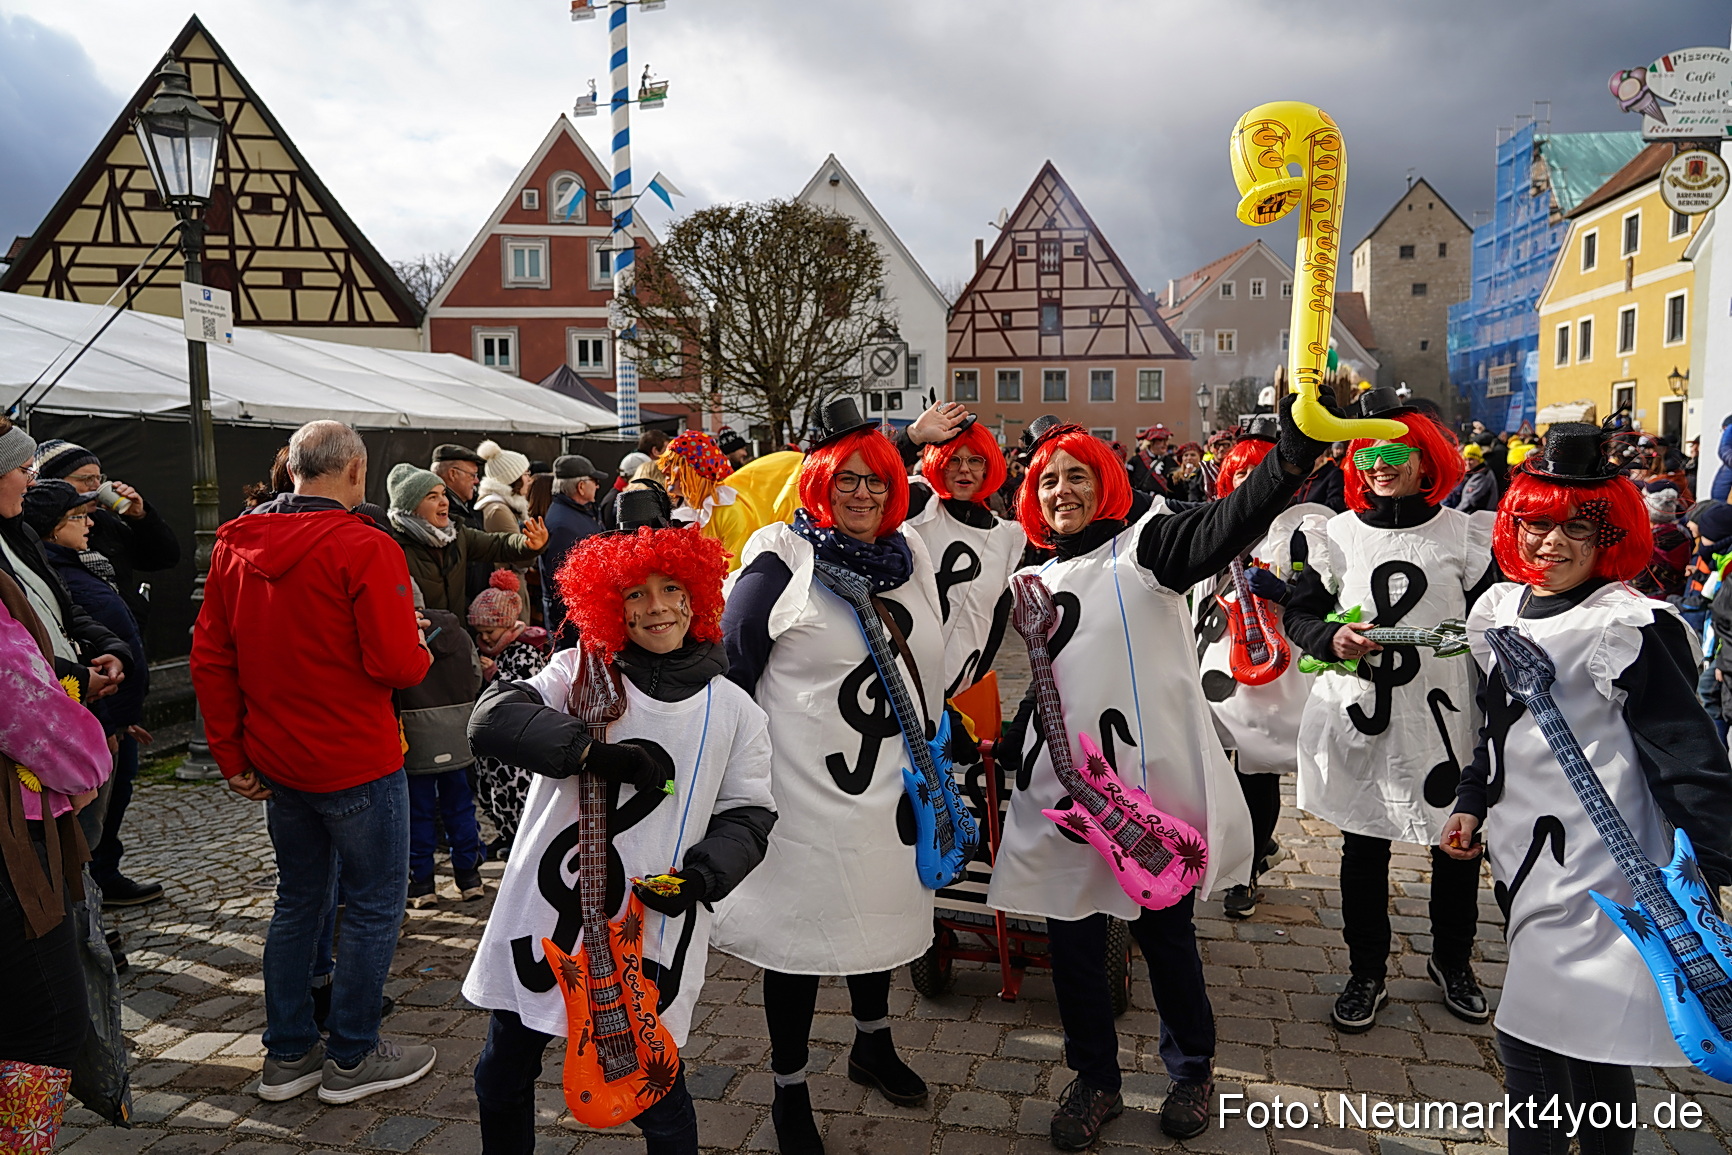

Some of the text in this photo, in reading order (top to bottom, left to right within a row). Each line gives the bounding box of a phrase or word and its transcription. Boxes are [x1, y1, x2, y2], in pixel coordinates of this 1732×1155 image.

[1673, 52, 1730, 66] Pizzeria
[1685, 71, 1716, 83] Café
[1669, 88, 1729, 103] Eisdiele
[1678, 116, 1719, 125] Bella
[1649, 125, 1694, 133] Roma
